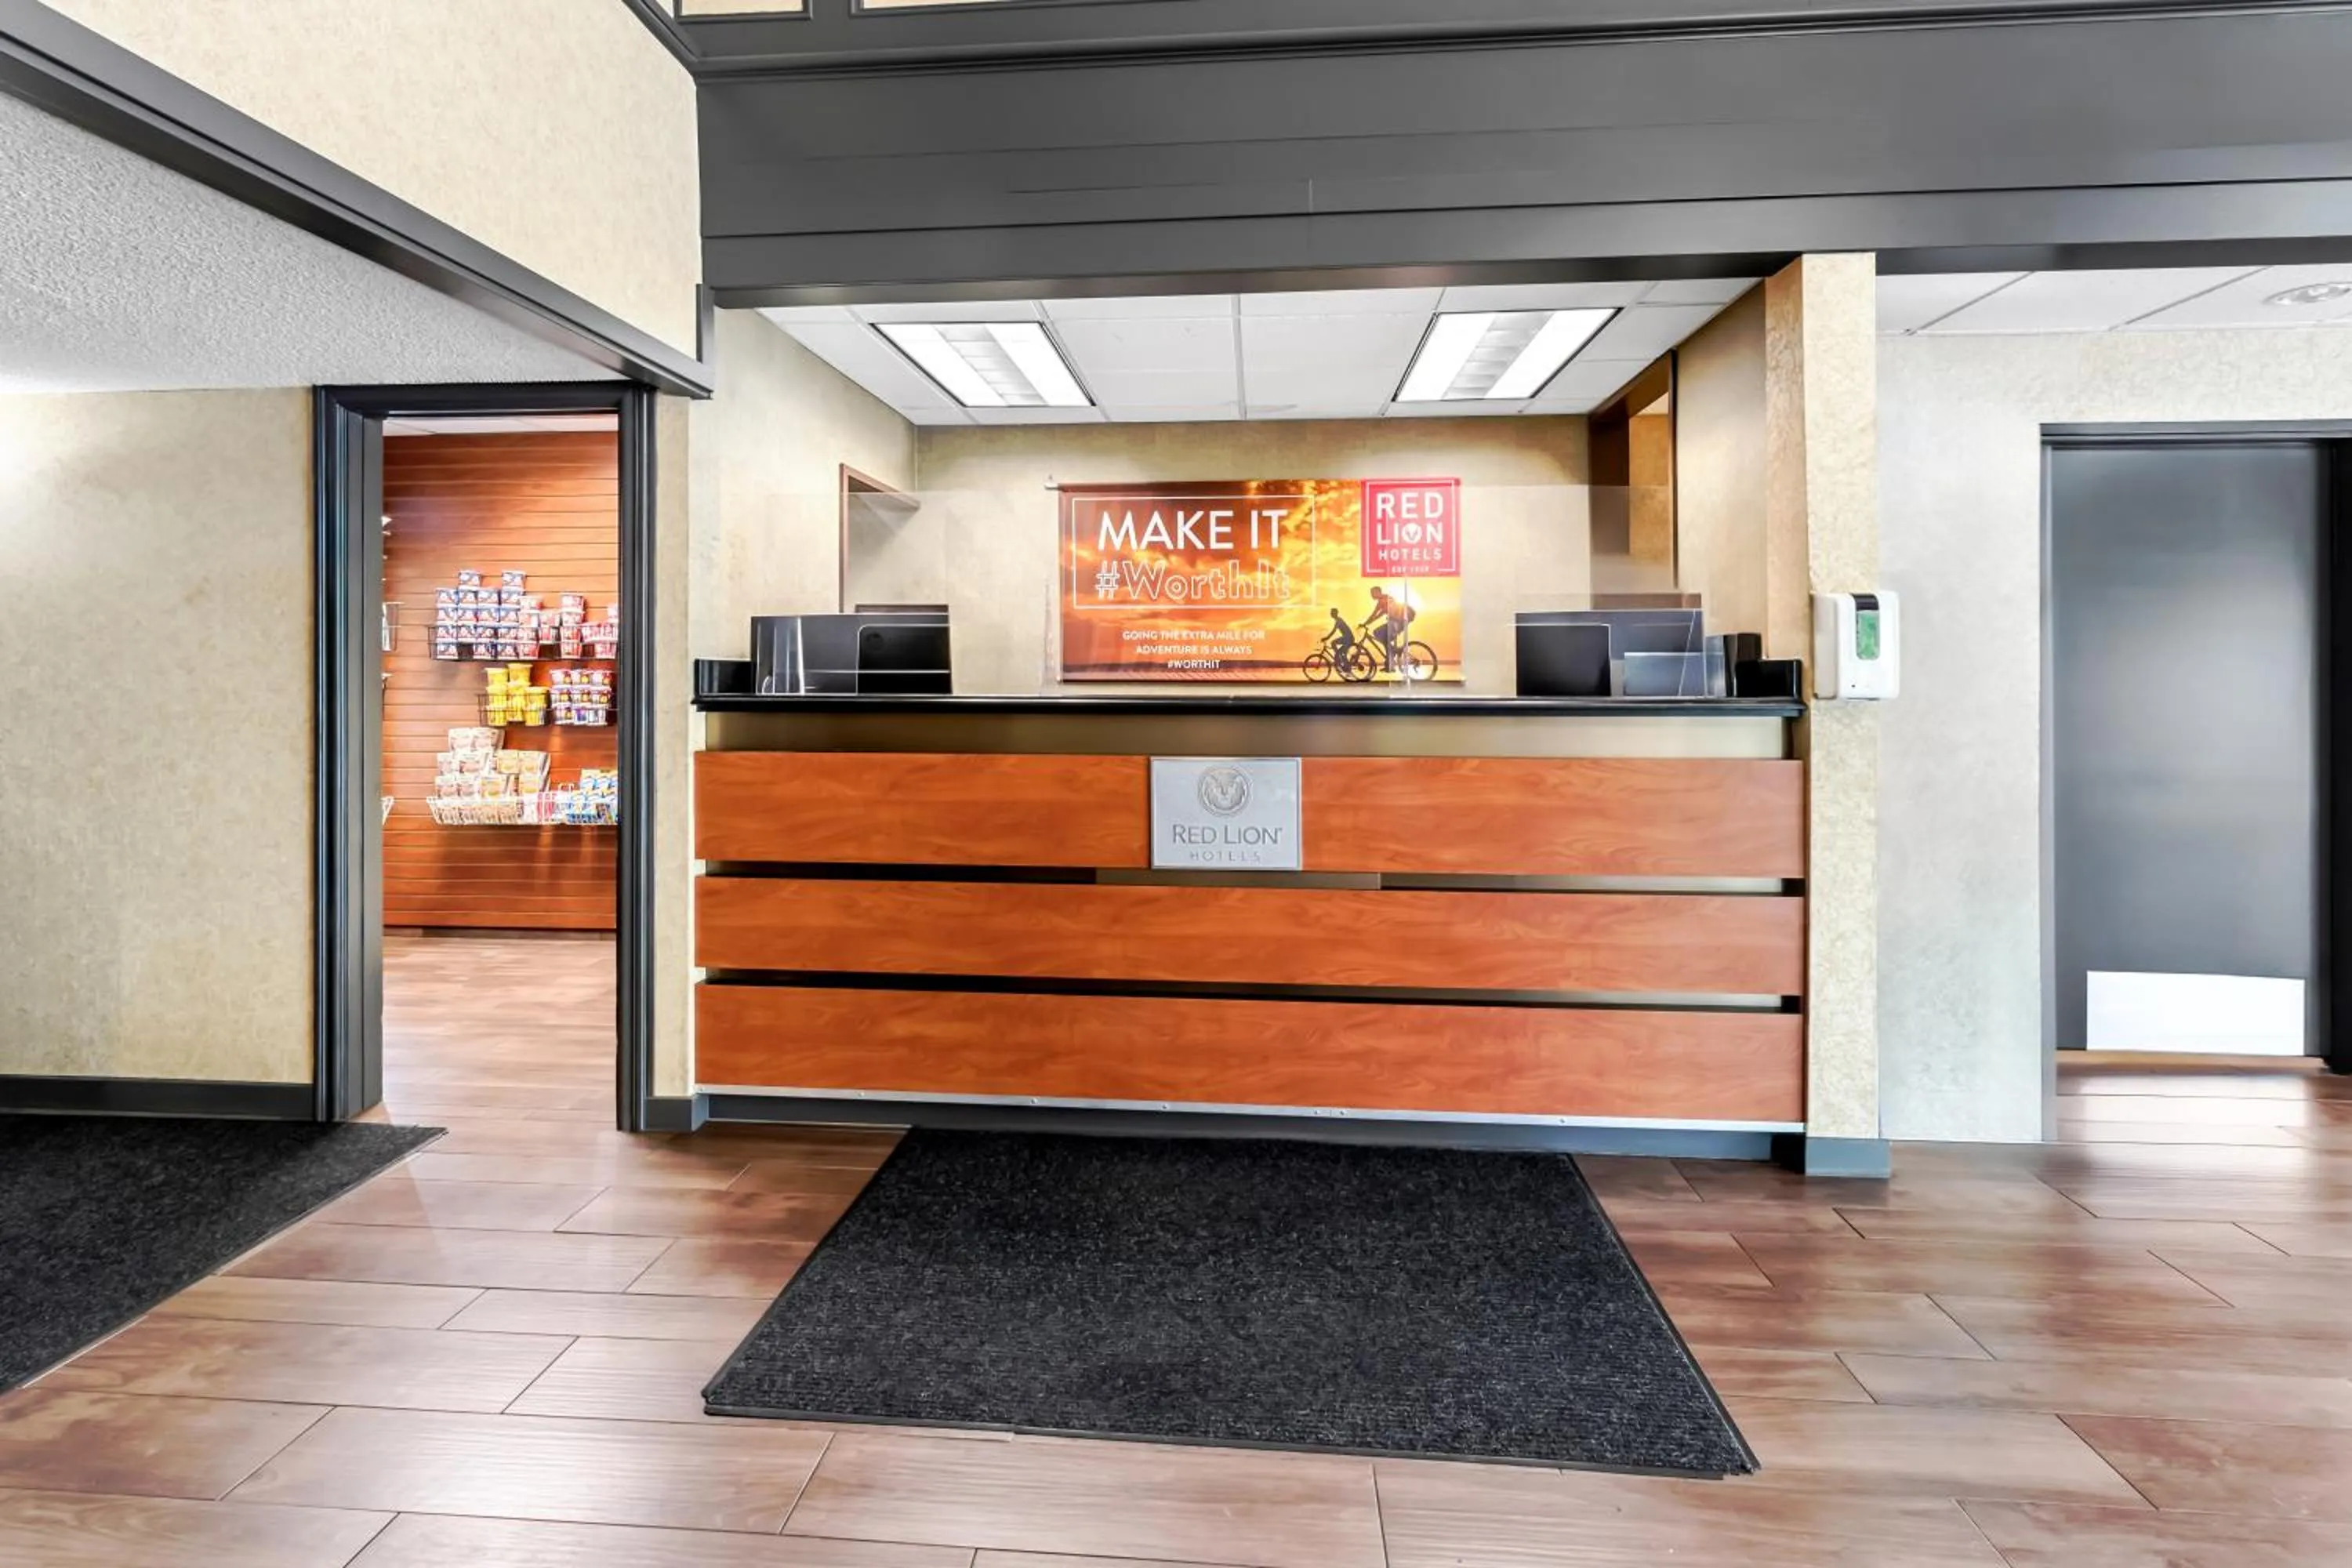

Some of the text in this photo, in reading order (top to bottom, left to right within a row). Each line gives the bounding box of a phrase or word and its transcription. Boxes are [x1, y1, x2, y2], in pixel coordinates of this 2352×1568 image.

[1376, 491, 1444, 519] RED
[1097, 509, 1288, 551] MAKE IT
[1376, 521, 1443, 545] LION
[1378, 547, 1443, 561] HOTELS
[1122, 630, 1265, 641] GOING THE EXTRA MILE FOR
[1136, 644, 1253, 655] ADVENTURE IS ALWAYS
[1167, 659, 1221, 669] #WORTHIT
[1172, 824, 1279, 844] RED LION
